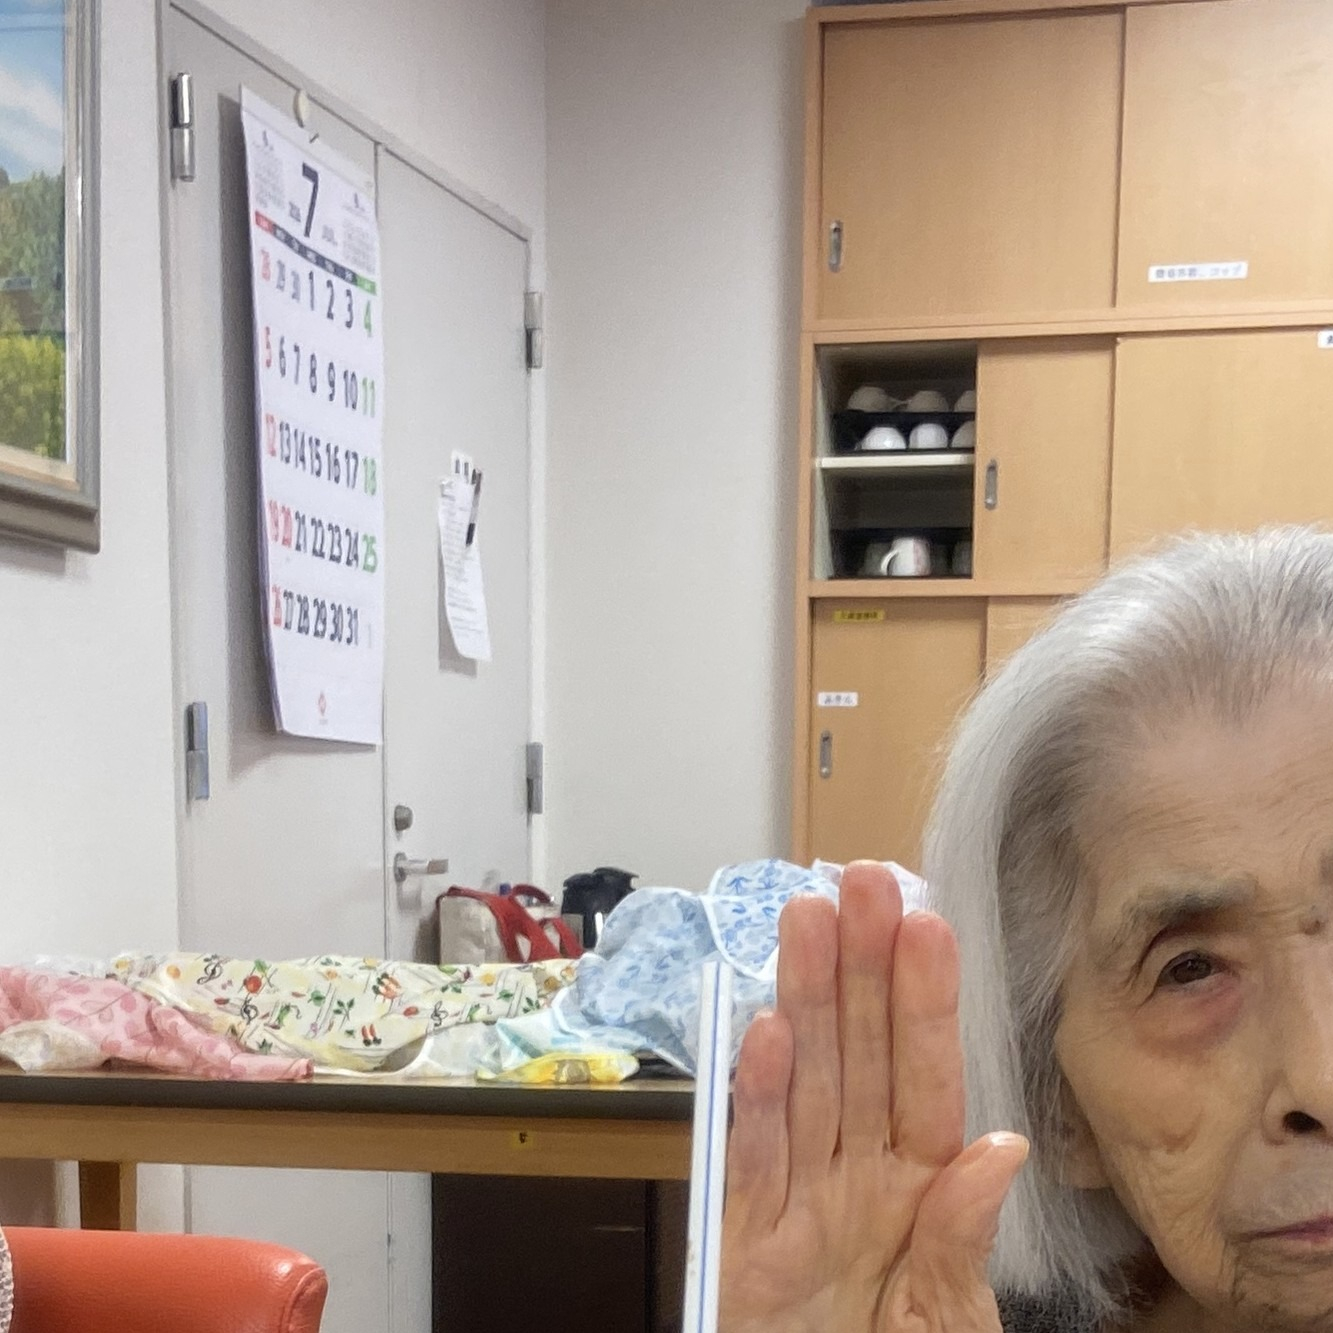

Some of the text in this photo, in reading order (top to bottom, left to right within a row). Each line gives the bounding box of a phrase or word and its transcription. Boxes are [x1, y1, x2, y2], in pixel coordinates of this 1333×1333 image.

[302, 162, 319, 238] 7
[308, 270, 314, 311] 1
[326, 279, 335, 320] 2
[345, 289, 353, 329] 3
[363, 300, 373, 337] 4
[265, 326, 376, 417] 5 6 7 8 9 10 11
[279, 421, 291, 464] 13
[294, 428, 306, 471] 14
[308, 436, 322, 478] 15
[326, 443, 341, 484] 16
[345, 450, 359, 489] 17
[362, 456, 377, 496] 18
[295, 510, 307, 553] 21
[311, 517, 326, 558] 22
[327, 523, 342, 564] 23
[345, 528, 359, 567] 24
[362, 535, 377, 573] 25
[297, 595, 310, 636] 28
[313, 598, 327, 639] 29
[330, 603, 344, 643] 30
[346, 607, 358, 646] 31
